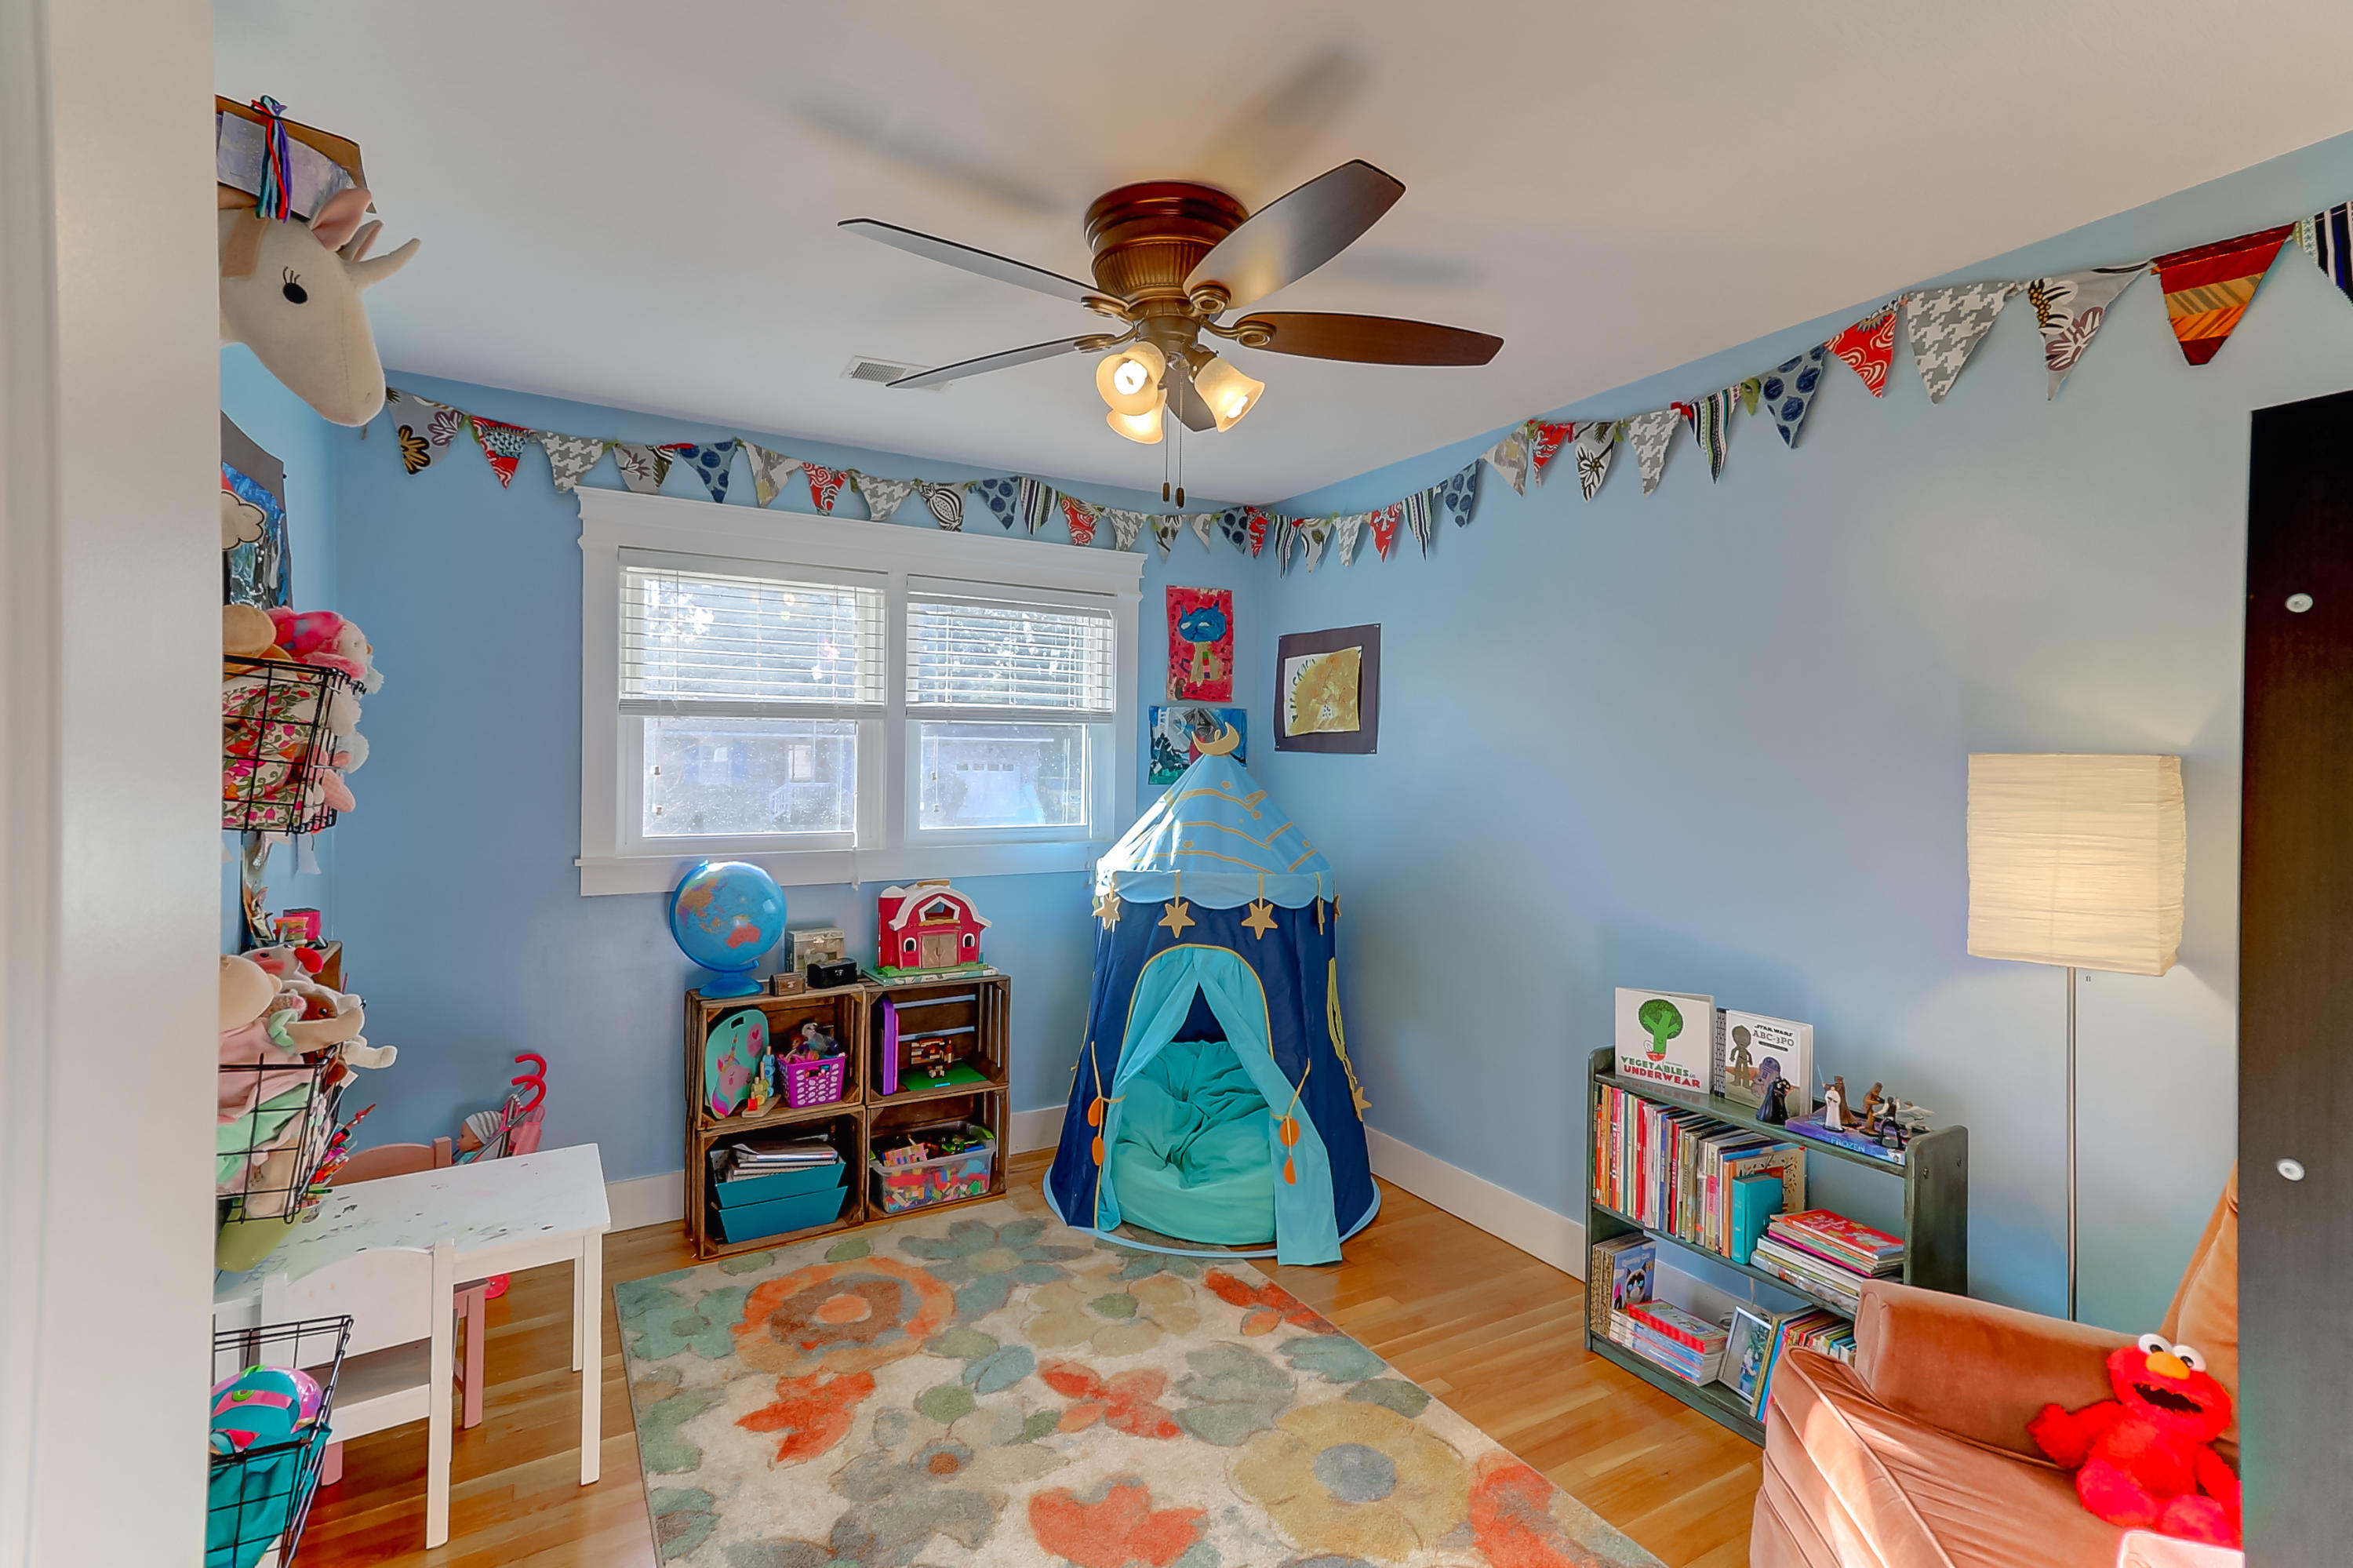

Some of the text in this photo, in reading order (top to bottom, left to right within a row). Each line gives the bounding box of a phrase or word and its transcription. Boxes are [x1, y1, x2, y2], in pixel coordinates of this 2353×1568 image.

[1752, 1029, 1795, 1047] ABC-3PO
[1754, 1024, 1794, 1037] STAR WARS
[1620, 1055, 1689, 1077] VEGETABLES
[1624, 1064, 1701, 1089] UNDERWEAR
[1830, 1136, 1866, 1153] FROZEN
